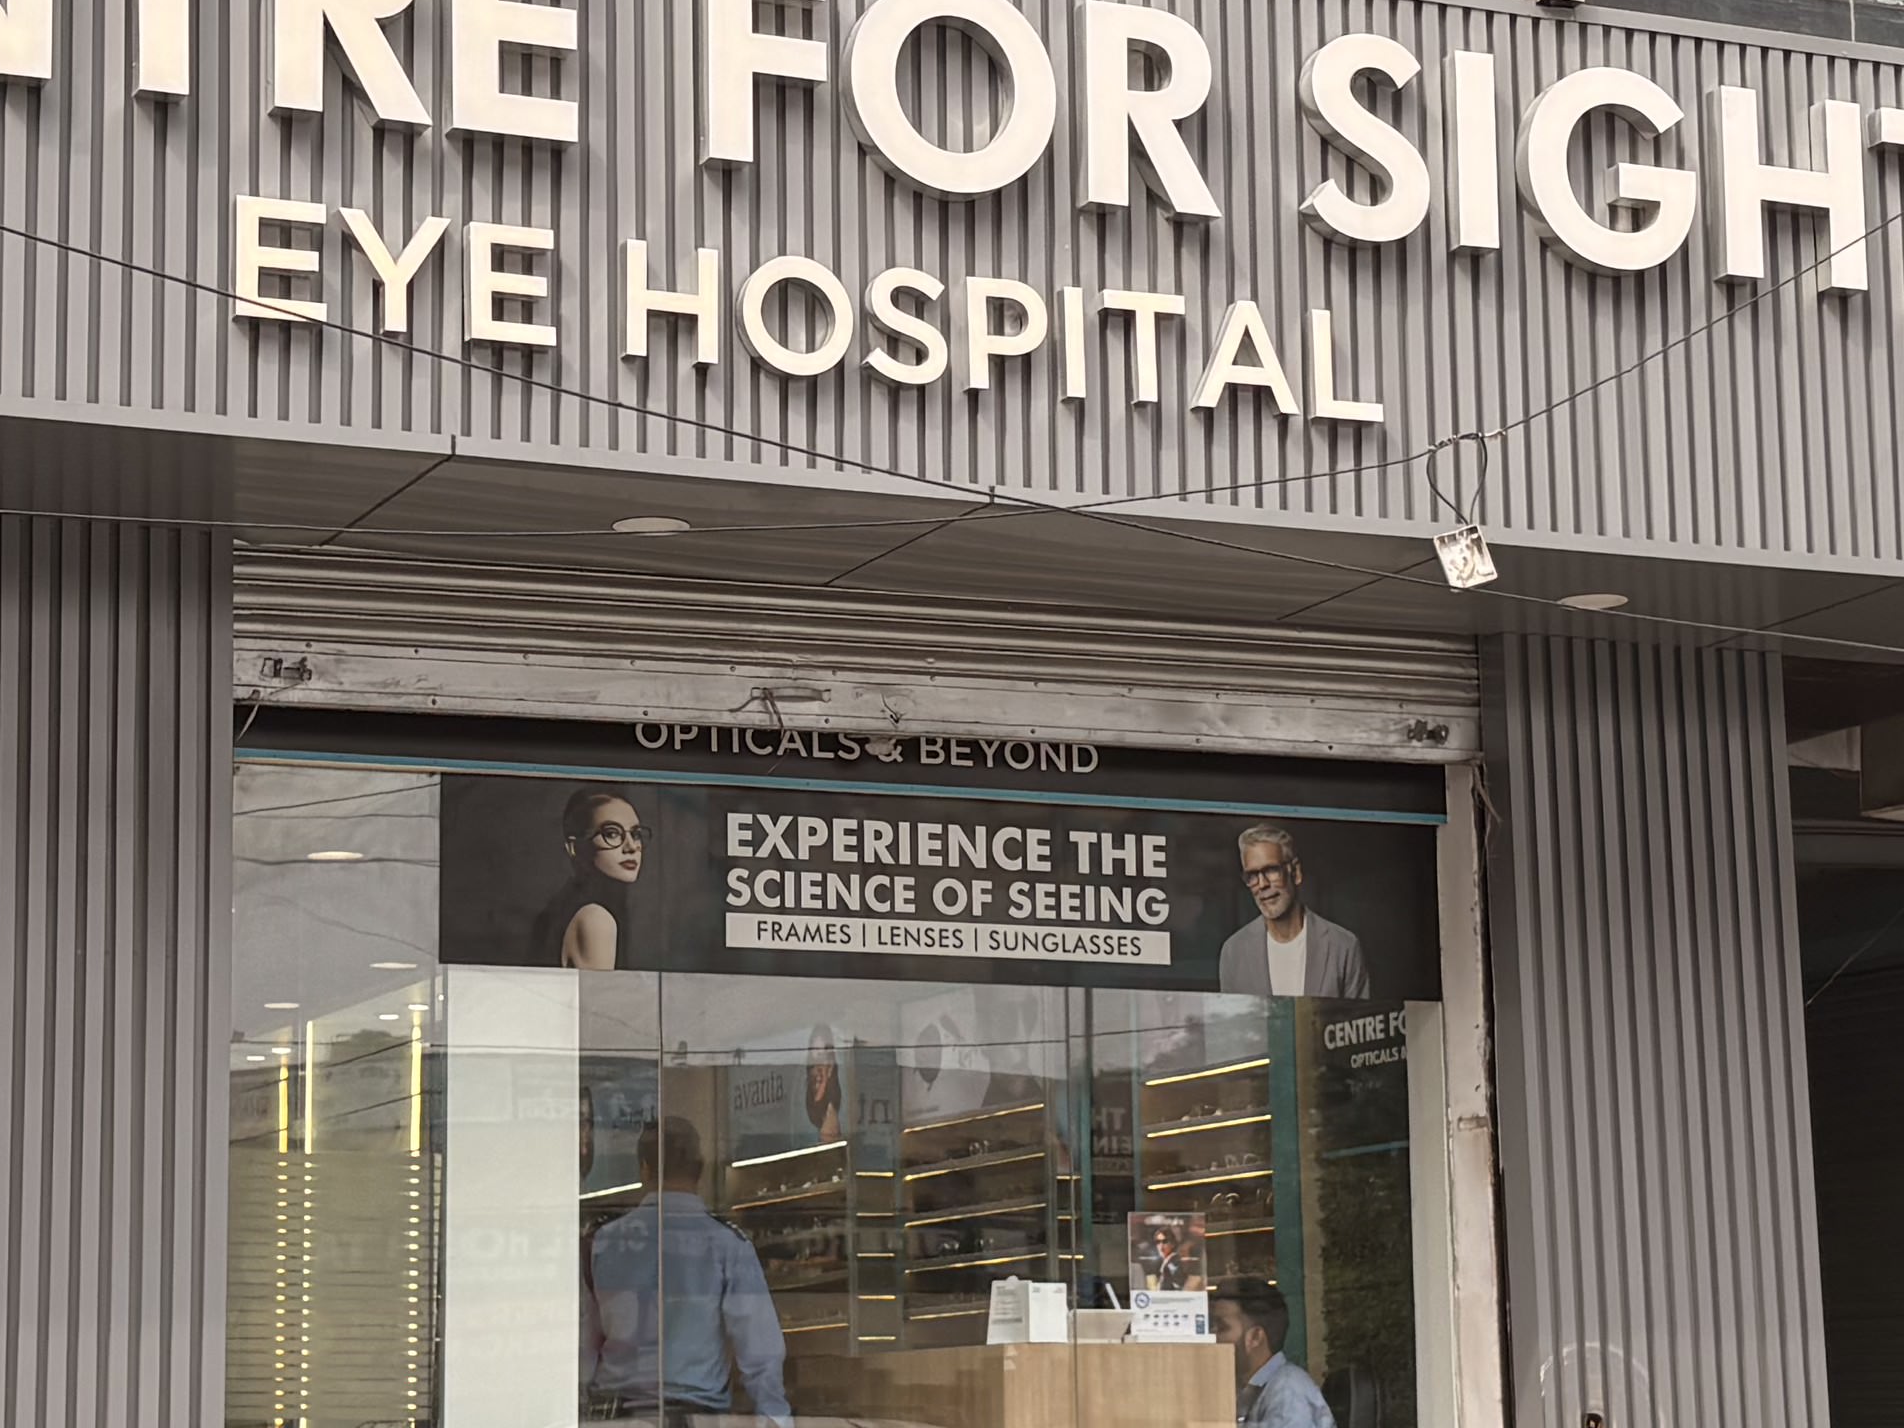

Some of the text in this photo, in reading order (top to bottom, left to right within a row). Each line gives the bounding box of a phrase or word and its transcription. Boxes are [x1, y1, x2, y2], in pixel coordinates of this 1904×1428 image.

[234, 194, 1385, 424] EYE HOSPITAL
[726, 812, 1168, 878] EXPERIENCE THE
[725, 868, 1170, 925] SCIENCE OF SEEING
[756, 920, 1142, 958] FRAMES LENSES SUNGLASSES
[1324, 1014, 1385, 1050] CENTRE
